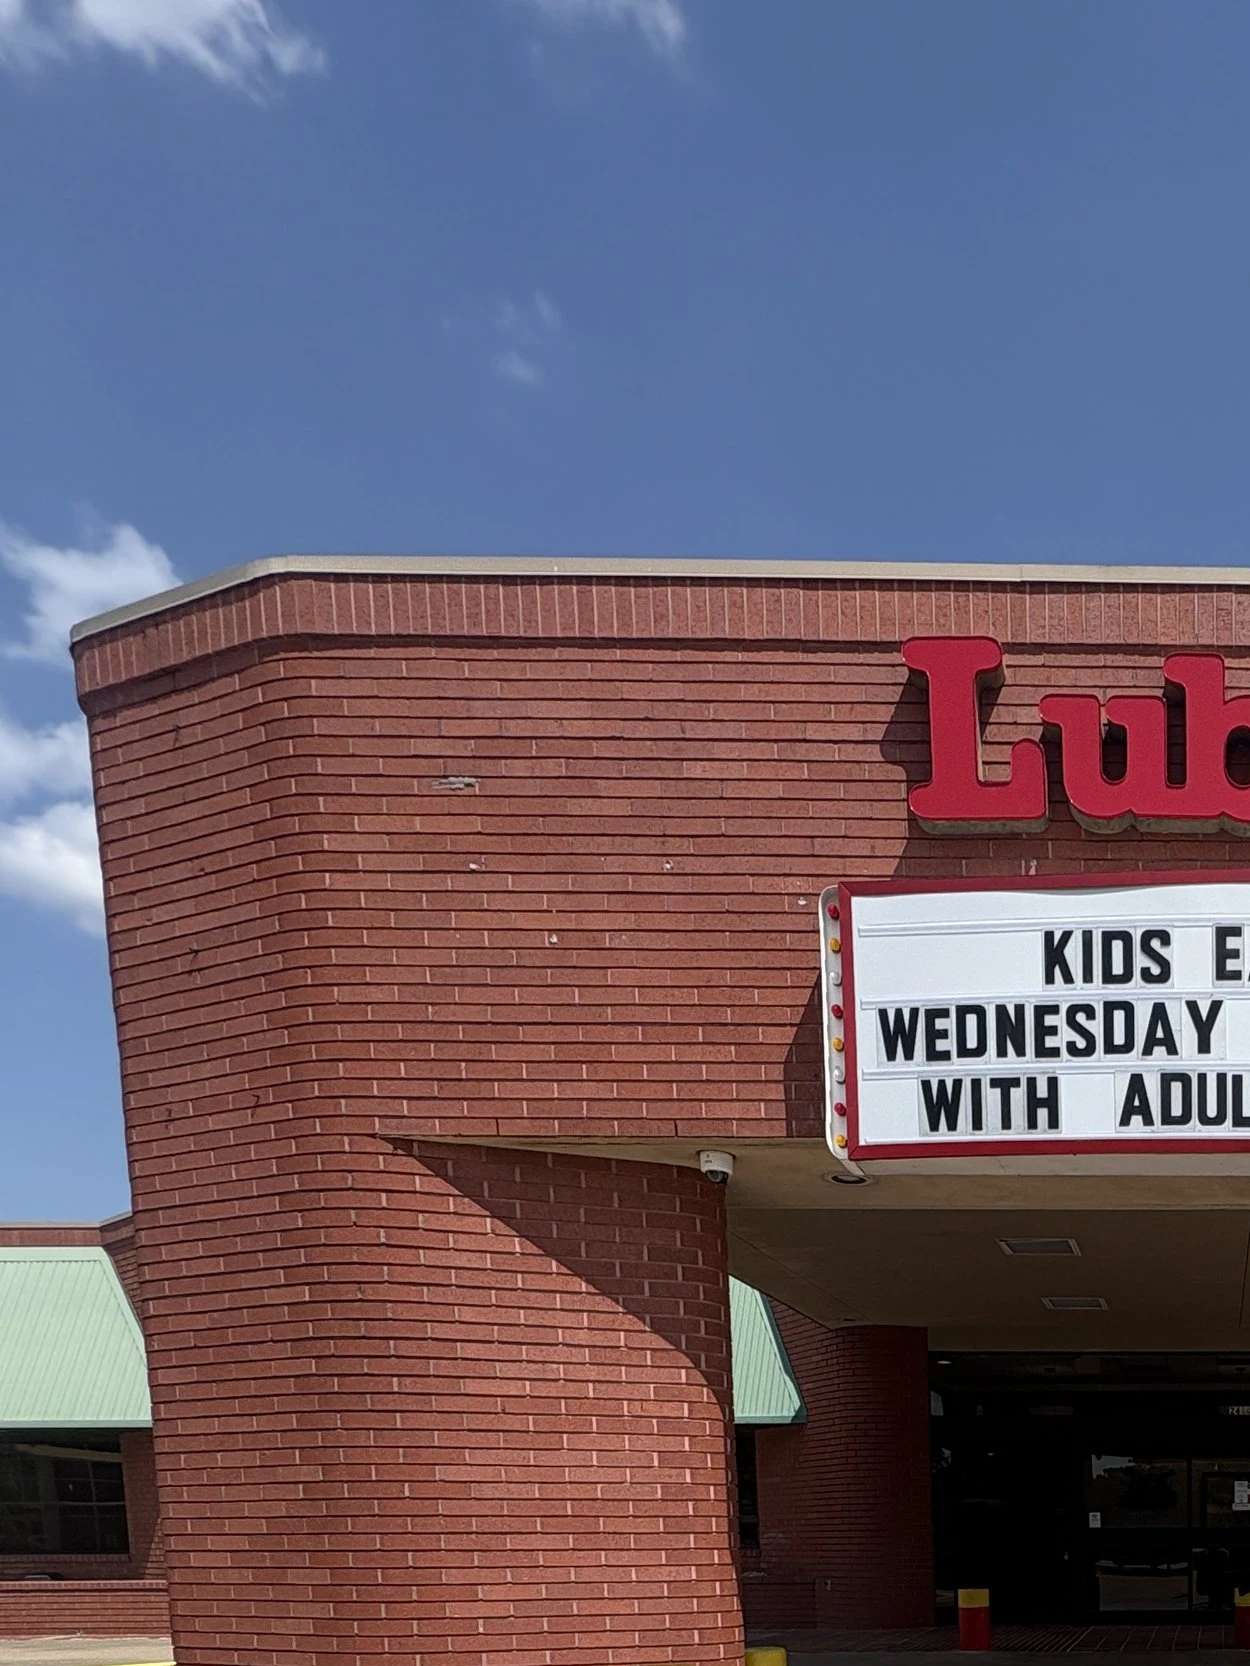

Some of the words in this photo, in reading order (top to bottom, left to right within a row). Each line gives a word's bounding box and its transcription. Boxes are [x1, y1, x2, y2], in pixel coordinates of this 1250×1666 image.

[1043, 929, 1171, 985] KIDS
[878, 999, 1224, 1062] WEDNESDAY
[920, 1076, 1060, 1133] WITH
